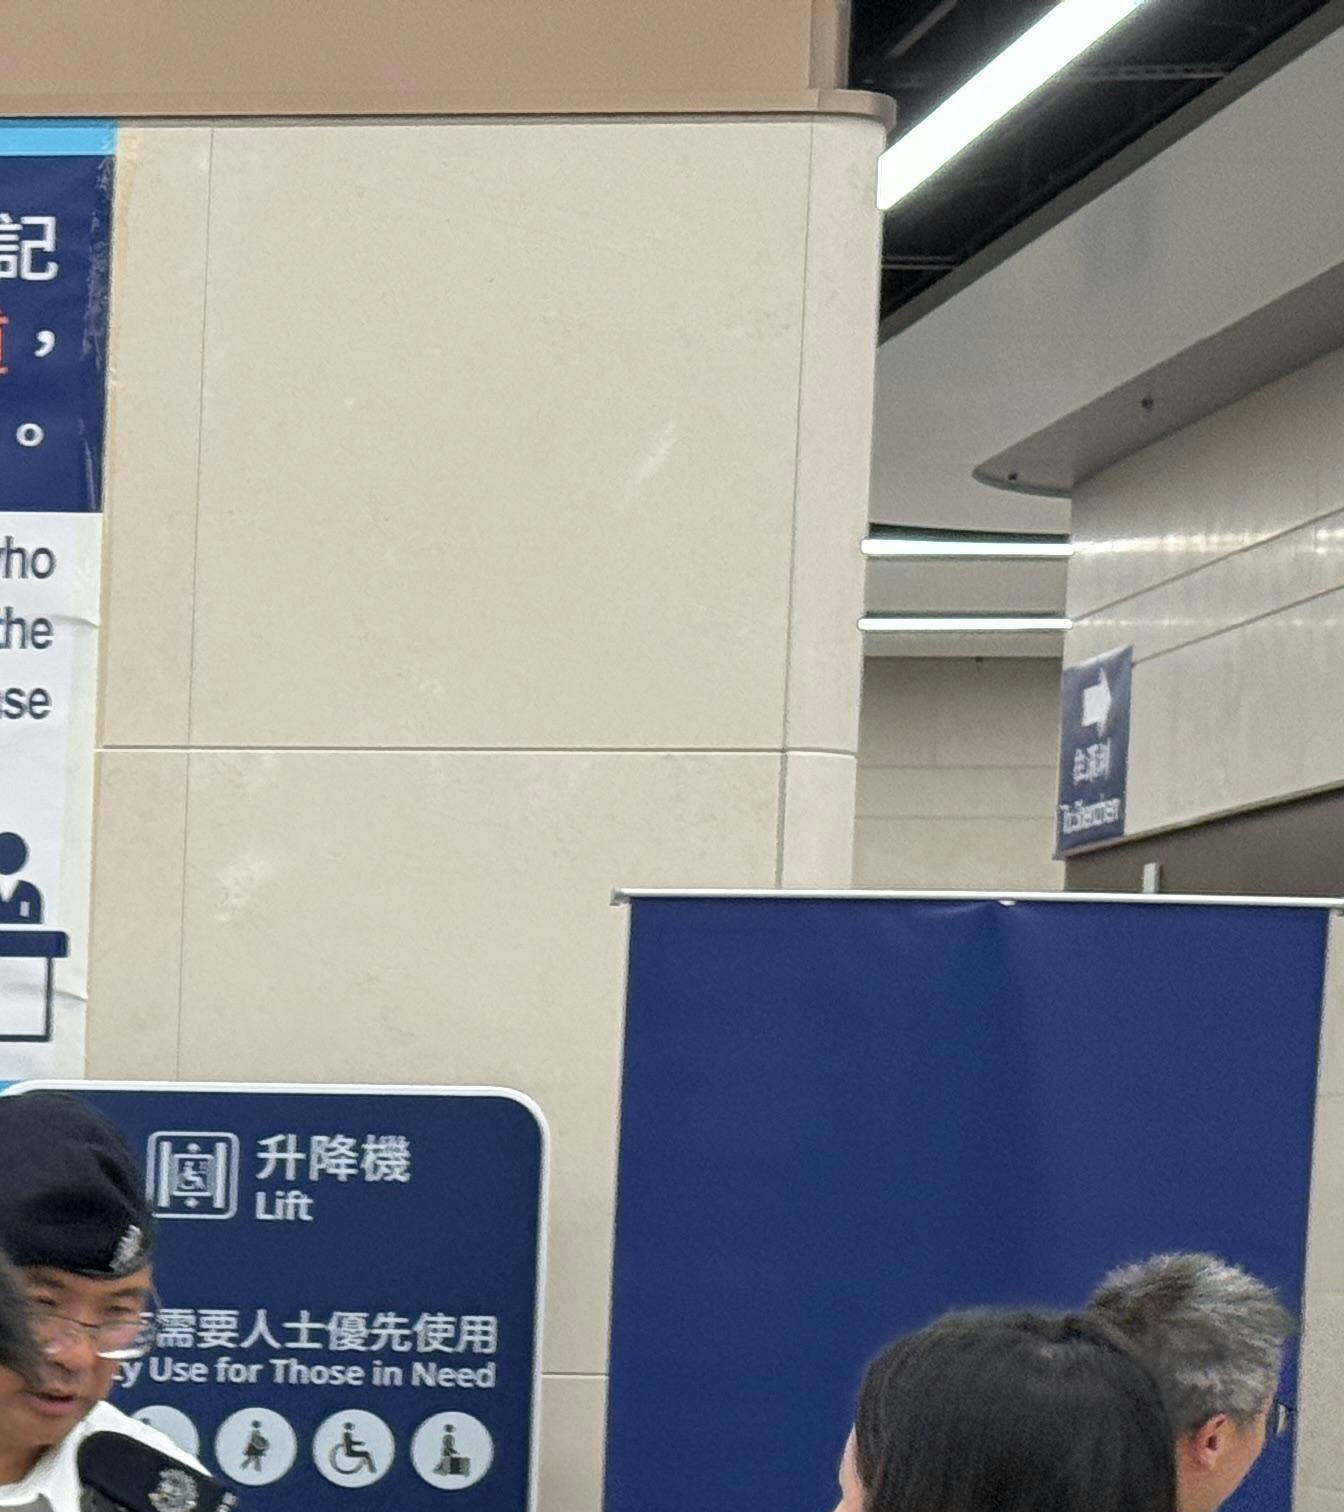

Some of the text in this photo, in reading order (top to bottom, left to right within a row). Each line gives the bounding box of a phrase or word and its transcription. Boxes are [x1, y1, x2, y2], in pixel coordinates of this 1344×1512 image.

[256, 1133, 411, 1183] 升降機
[255, 1191, 314, 1221] Lift
[139, 1308, 498, 1355] 需要人士優先使用
[149, 1356, 209, 1383] Use
[215, 1356, 263, 1384] for
[269, 1358, 365, 1385] Those
[372, 1360, 403, 1386] in
[411, 1361, 496, 1388] Need
